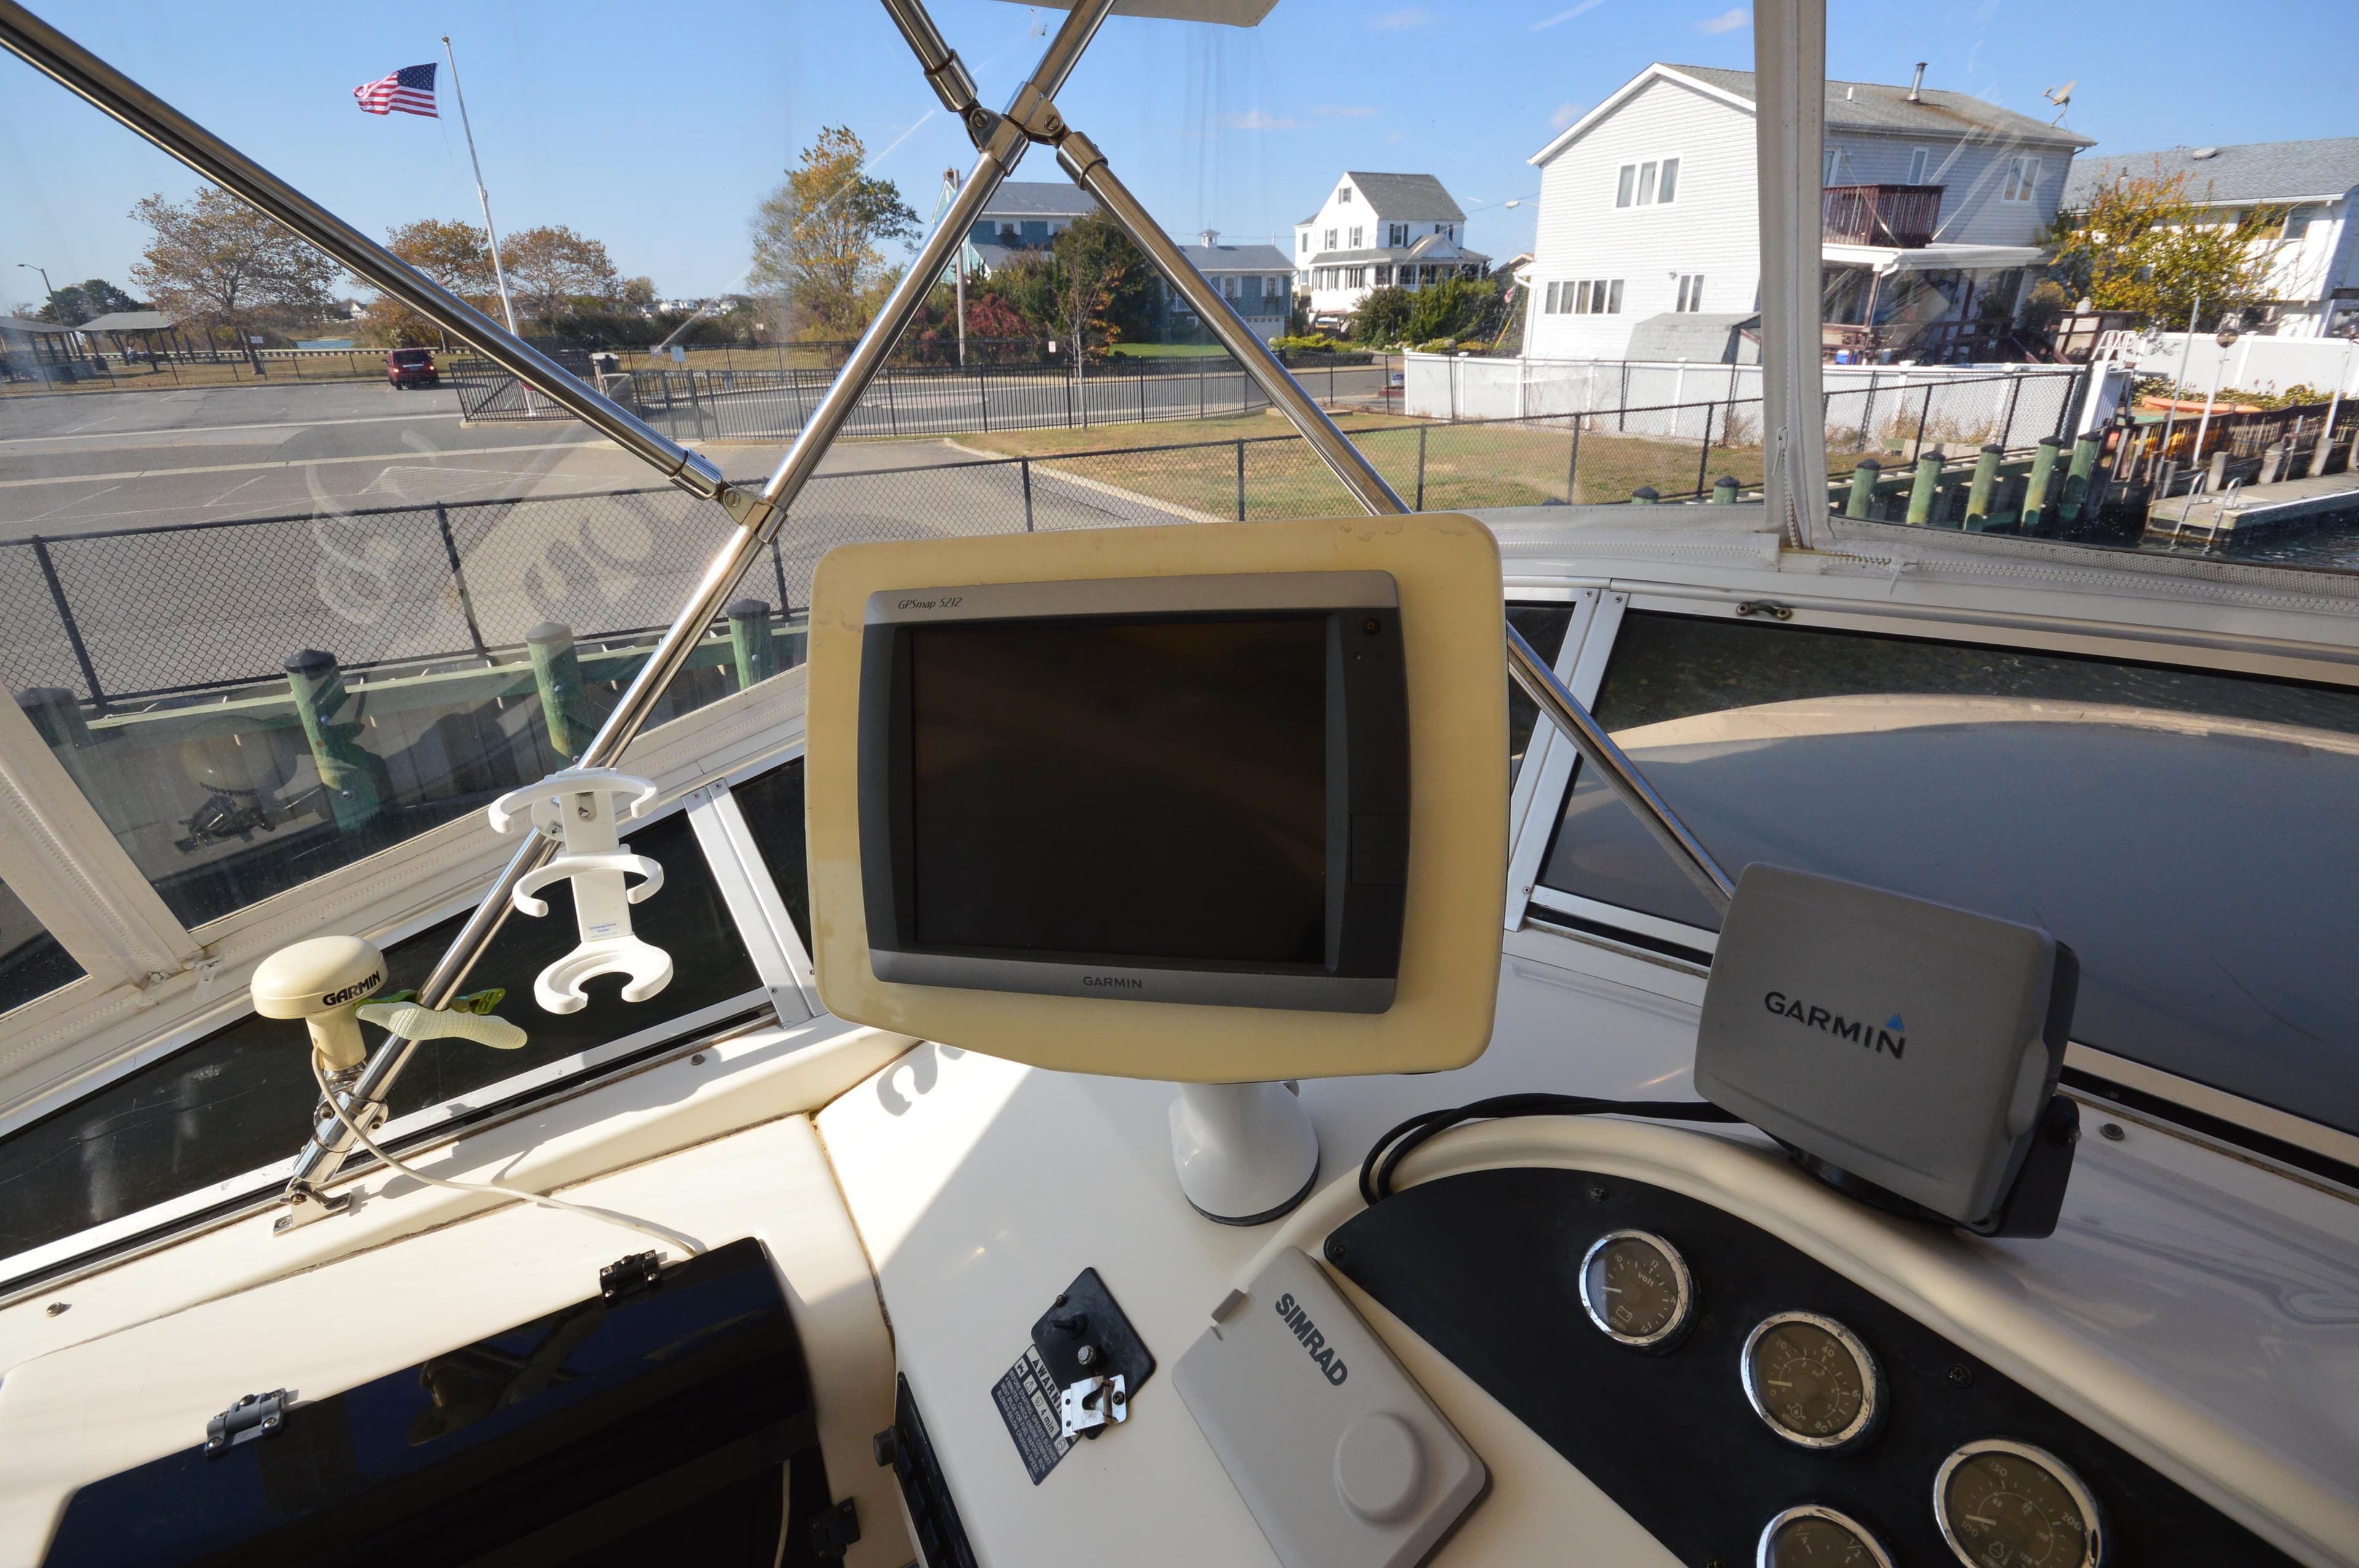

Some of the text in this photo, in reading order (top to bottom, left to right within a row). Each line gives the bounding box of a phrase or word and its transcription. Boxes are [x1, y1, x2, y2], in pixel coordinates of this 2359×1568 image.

[939, 597, 963, 607] 5212
[323, 970, 381, 1006] GARMIN
[1083, 976, 1142, 988] GARMIN
[1764, 991, 1906, 1061] GARMIN
[1651, 1260, 1659, 1269] 12
[1638, 1272, 1655, 1287] volt
[1275, 1293, 1348, 1386] SIMRAD
[1775, 1339, 1787, 1349] 20
[1821, 1346, 1834, 1357] 40
[1036, 1363, 1064, 1415] WARNI
[996, 1389, 1010, 1412] BLOWER
[1006, 1410, 1019, 1430] BELOW
[1015, 1428, 1030, 1456] CRUISING
[1008, 1370, 1021, 1391] BEFORE
[1031, 1414, 1046, 1440] OPERATE
[1043, 1437, 1057, 1463] BLOWER
[1017, 1401, 1029, 1421] CHECK
[1026, 1419, 1038, 1440] ENGINE
[1039, 1408, 1055, 1433] 4 min
[1815, 1421, 1828, 1433] 80
[1006, 1395, 1017, 1413] BILGE
[1014, 1410, 1023, 1424] FOR
[1020, 1421, 1029, 1437] FUEL
[1037, 1457, 1046, 1472] RUN
[1989, 1461, 2008, 1477] 150
